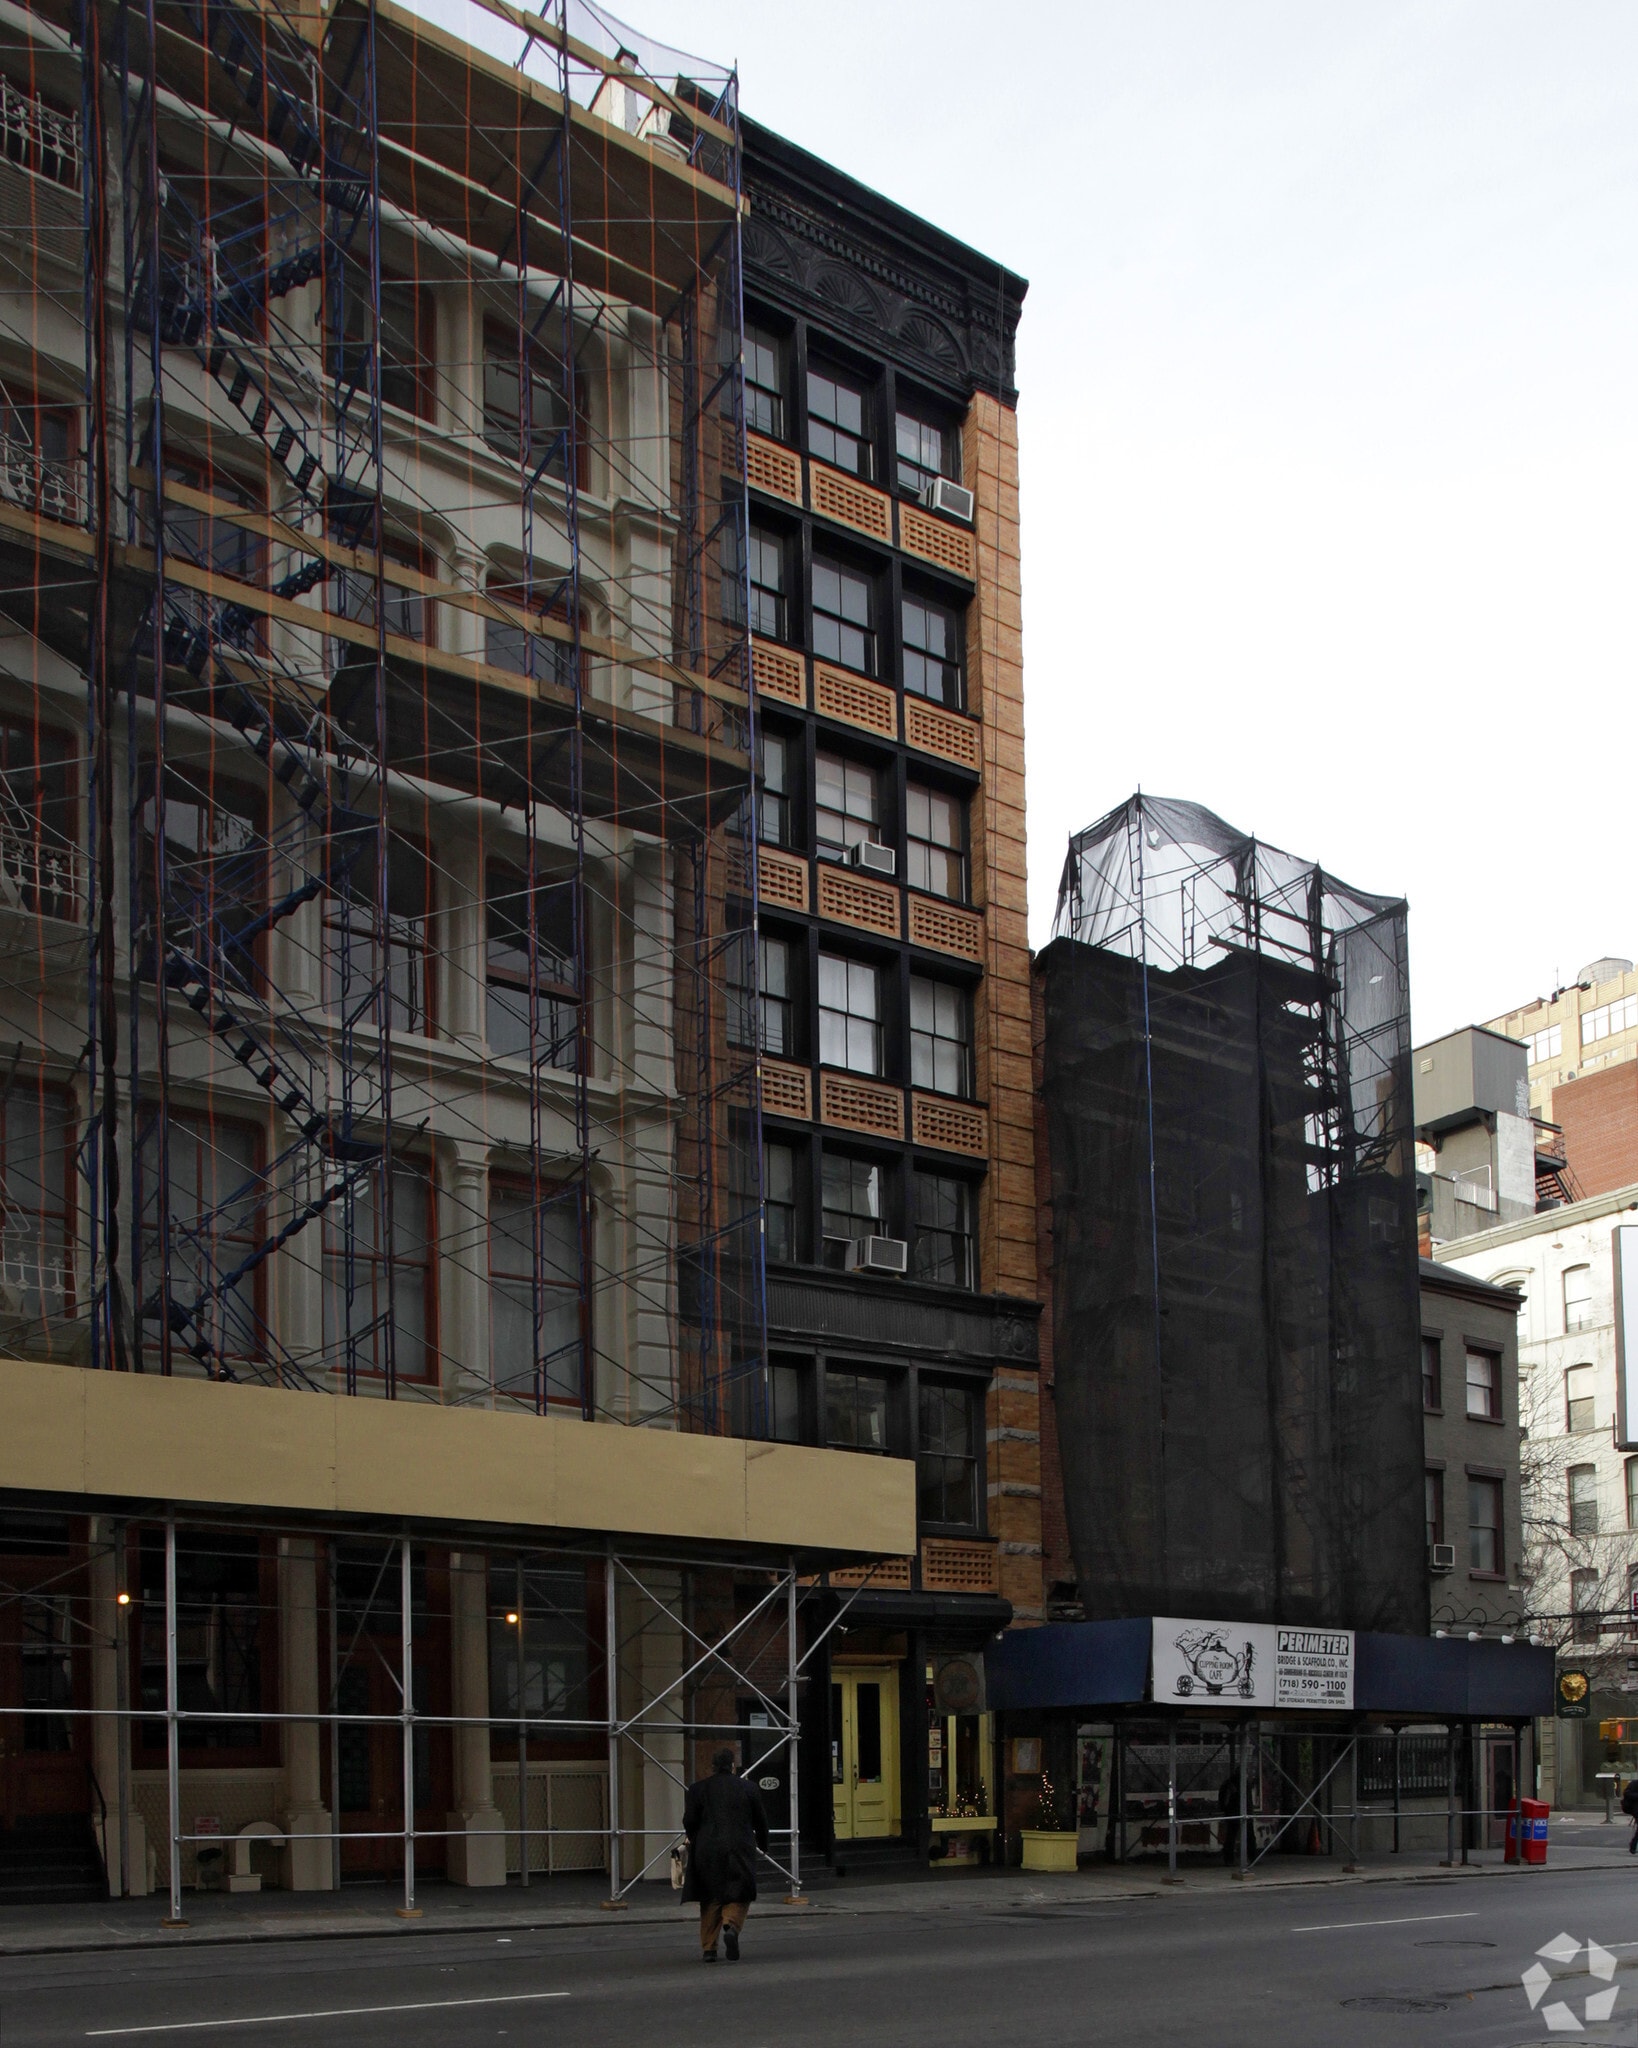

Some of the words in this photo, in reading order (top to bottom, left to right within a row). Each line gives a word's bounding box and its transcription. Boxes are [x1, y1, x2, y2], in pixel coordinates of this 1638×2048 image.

[1278, 1631, 1348, 1655] PERIMETER
[1277, 1655, 1296, 1666] BRIDGE
[1297, 1656, 1301, 1666] &
[1302, 1656, 1327, 1667] SCAFFOLD
[1279, 1678, 1299, 1688] (718)
[761, 1779, 778, 1788] 495
[1533, 1818, 1548, 1827] VOICE
